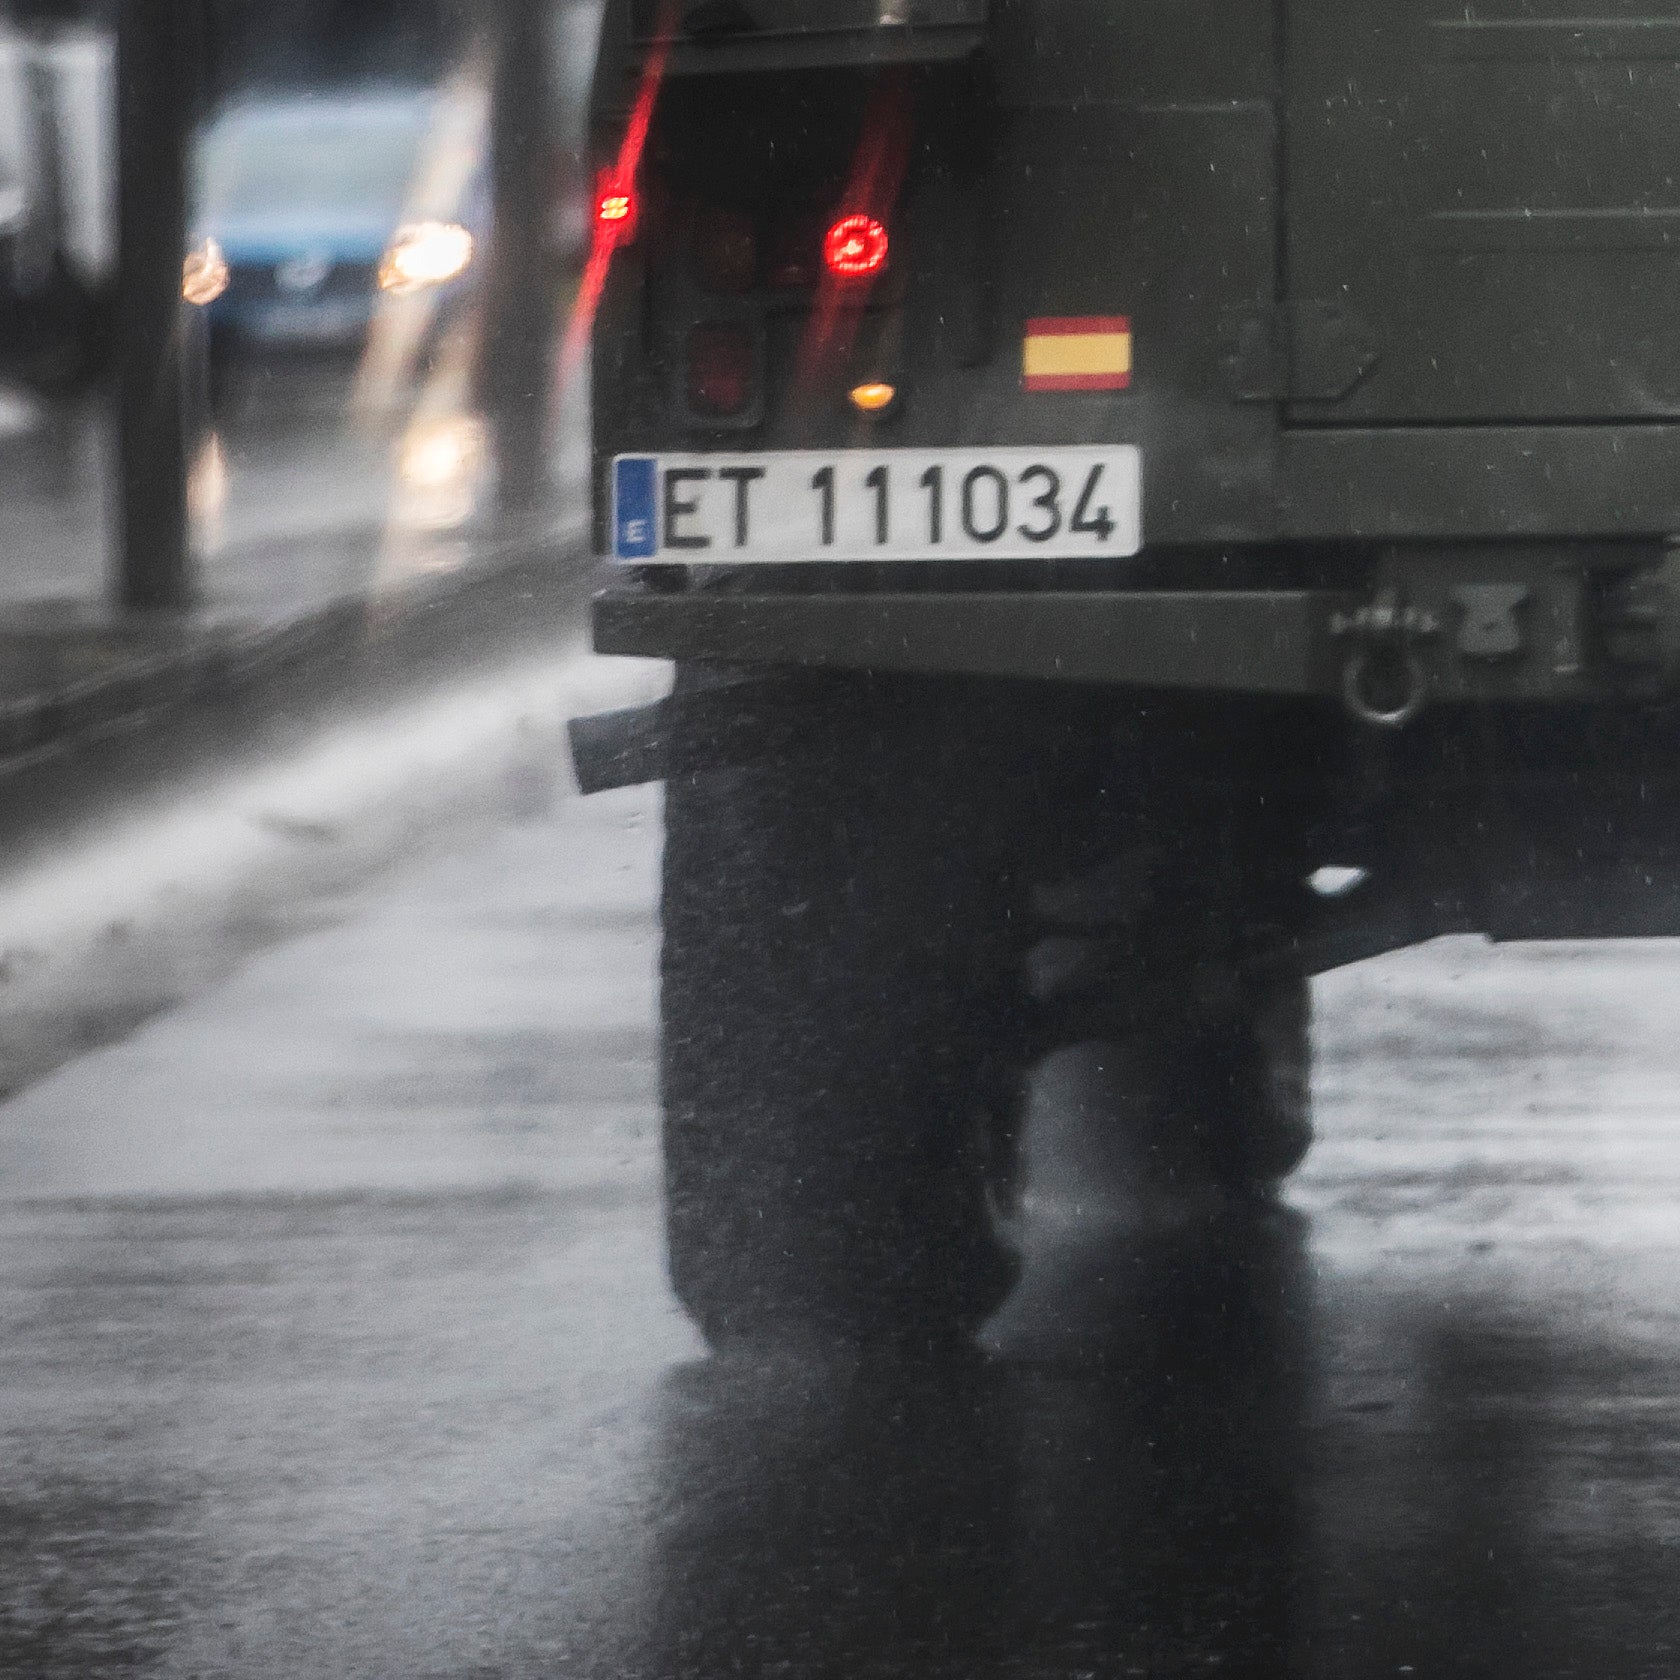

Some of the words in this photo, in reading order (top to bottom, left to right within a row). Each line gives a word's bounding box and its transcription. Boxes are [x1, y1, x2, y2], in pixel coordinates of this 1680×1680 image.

[625, 519, 647, 544] E
[663, 466, 766, 550] ET
[810, 463, 1115, 547] 111034
